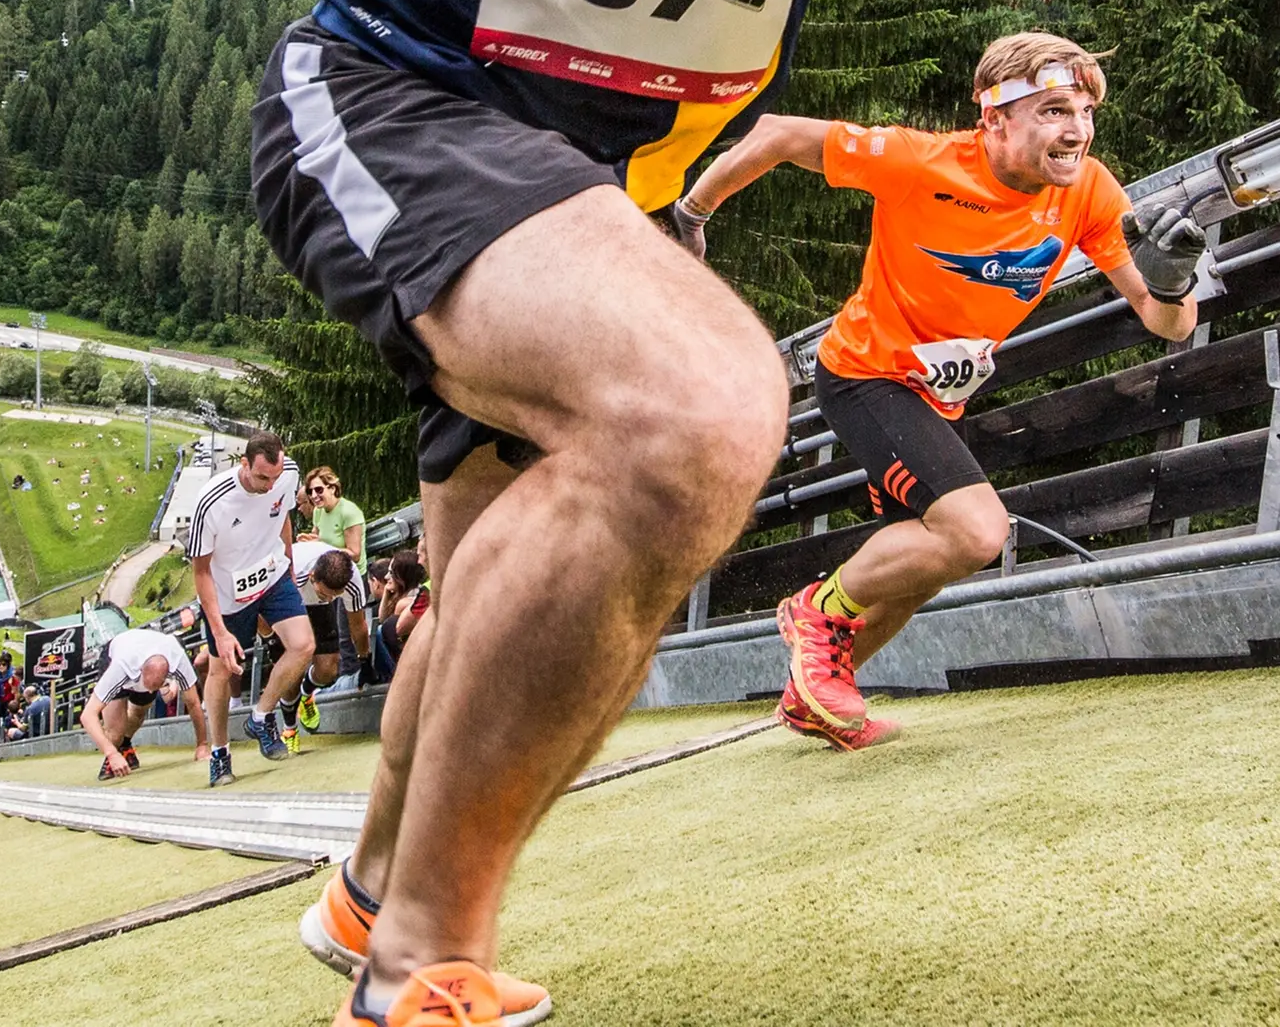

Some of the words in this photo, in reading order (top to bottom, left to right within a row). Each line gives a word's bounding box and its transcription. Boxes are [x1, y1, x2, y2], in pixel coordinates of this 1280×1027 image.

[500, 44, 550, 62] TERREX
[954, 199, 991, 214] KARHU
[236, 568, 268, 593] 352
[41, 642, 76, 656] 25m
